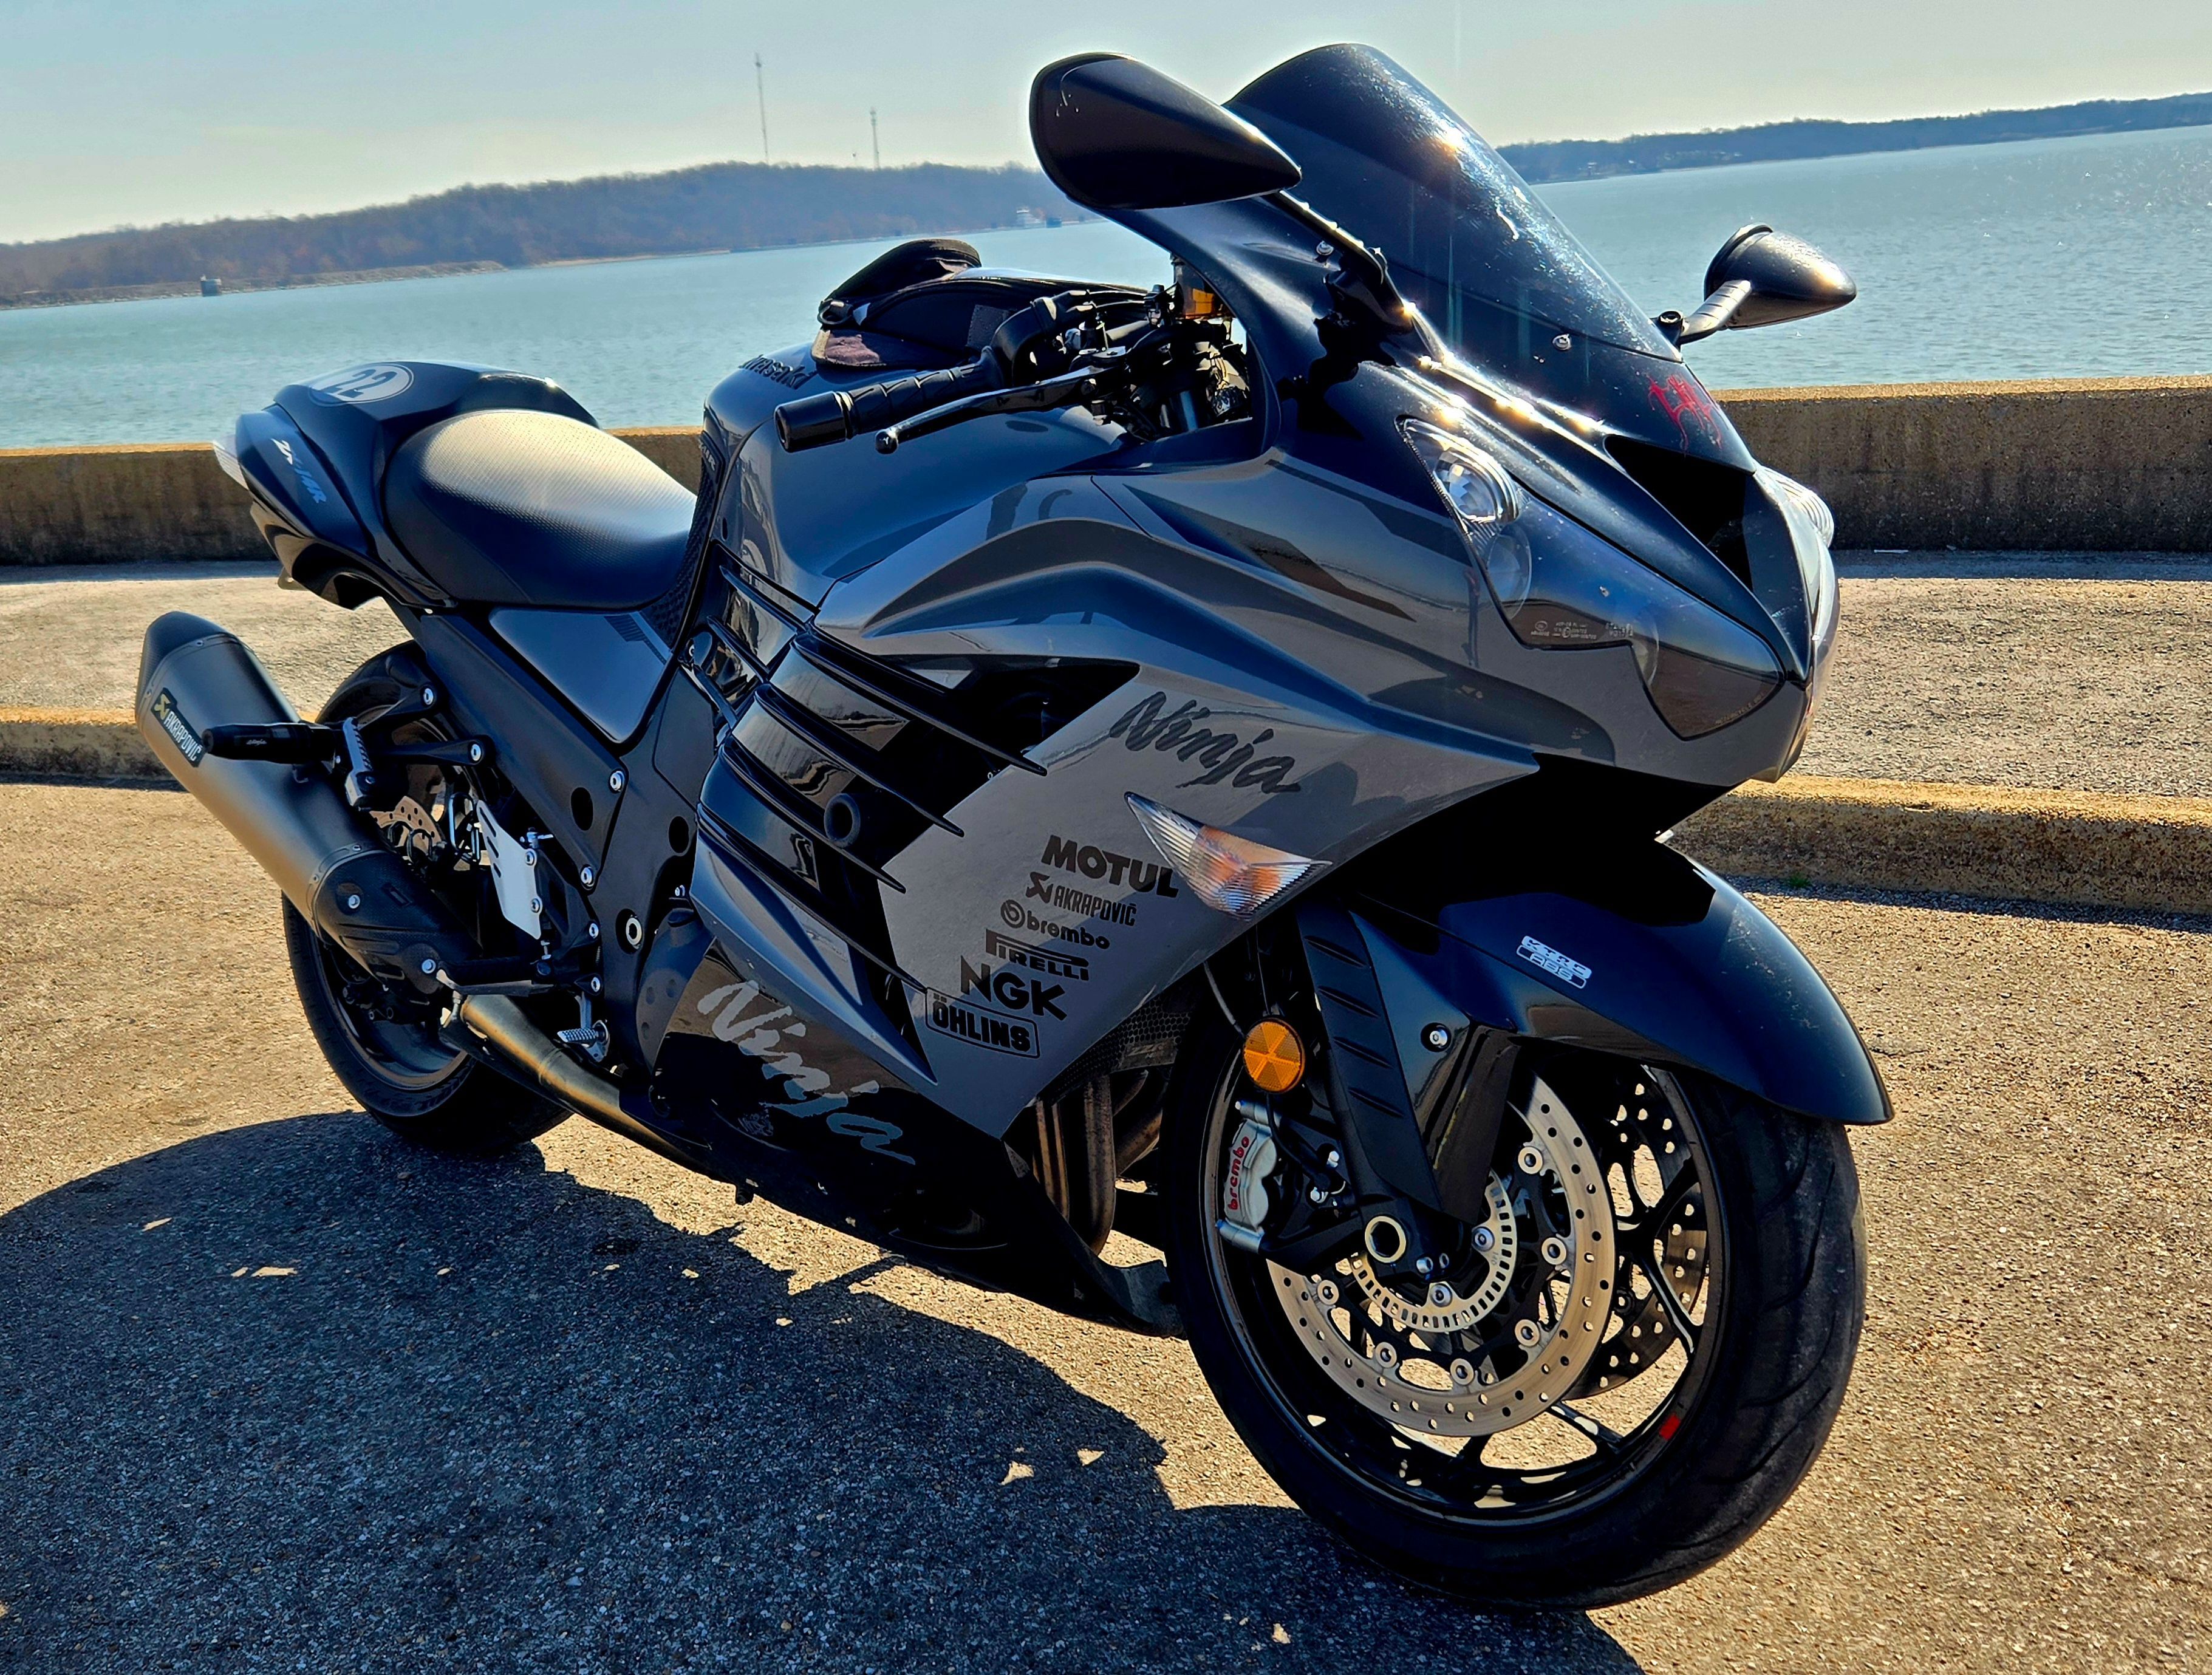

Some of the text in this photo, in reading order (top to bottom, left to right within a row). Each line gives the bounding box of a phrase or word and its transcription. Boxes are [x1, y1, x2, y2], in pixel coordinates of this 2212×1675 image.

[320, 369, 398, 398] 22
[1108, 691, 1302, 793] Ninja
[1040, 834, 1179, 898] MOTUL
[985, 929, 1090, 981] PIRELLI
[1028, 913, 1110, 949] brembo
[1527, 940, 1586, 975] KTRC
[960, 955, 1068, 1021] NGK
[1529, 953, 1574, 980] ABS
[933, 994, 1031, 1052] ÖHLINS
[697, 980, 916, 1165] Ninja
[1227, 1136, 1250, 1210] brembo
